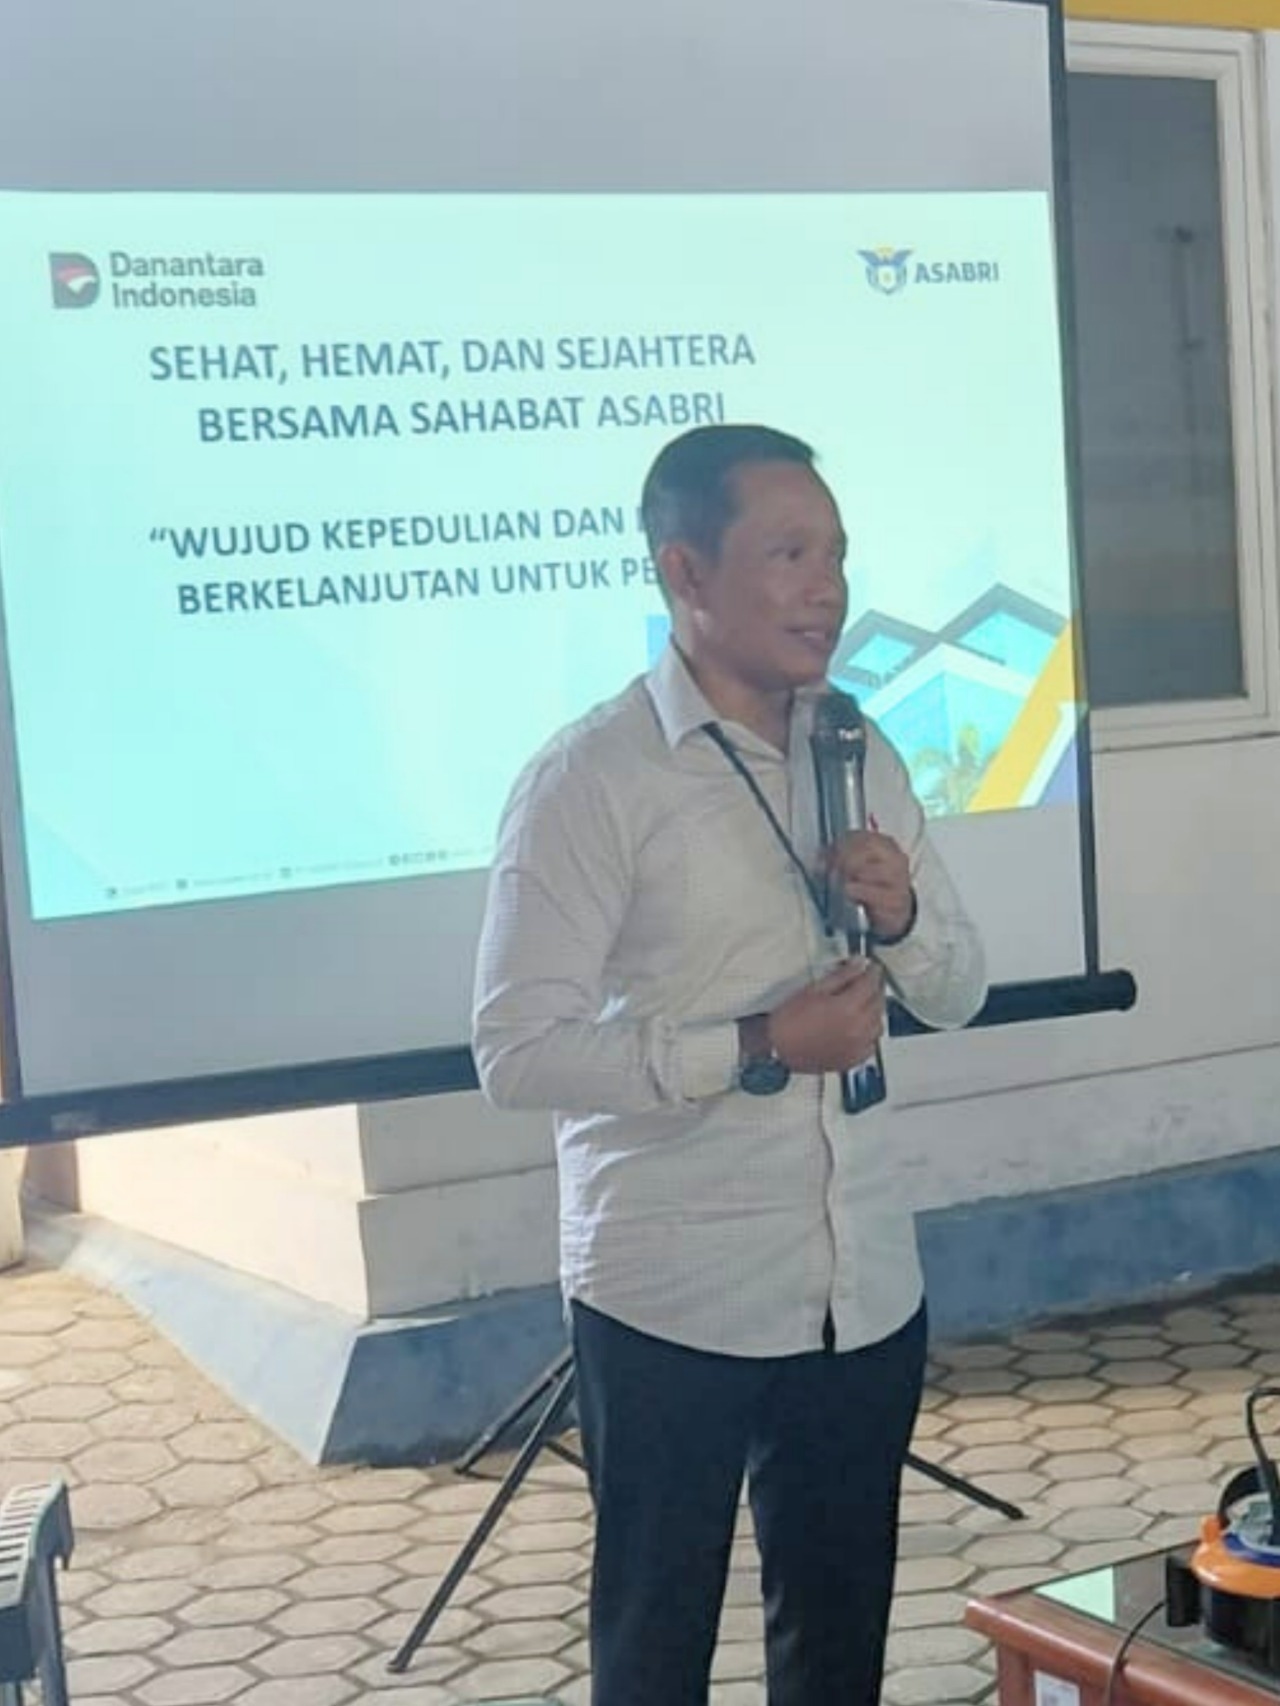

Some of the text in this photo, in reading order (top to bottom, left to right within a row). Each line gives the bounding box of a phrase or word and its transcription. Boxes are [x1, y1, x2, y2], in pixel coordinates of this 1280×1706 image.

[108, 251, 265, 278] Danantara
[914, 261, 1000, 284] ASABRI
[111, 281, 257, 308] Indonesia
[149, 333, 757, 386] SEHAT, HEMAT, DAN SEJAHTERA
[197, 391, 725, 444] BERSAMA SAHABAT ASABRI
[320, 510, 542, 552] KEPEDULIAN
[552, 506, 625, 539] DAN
[176, 556, 659, 616] BERKELANJUTAN UNTUK PE
